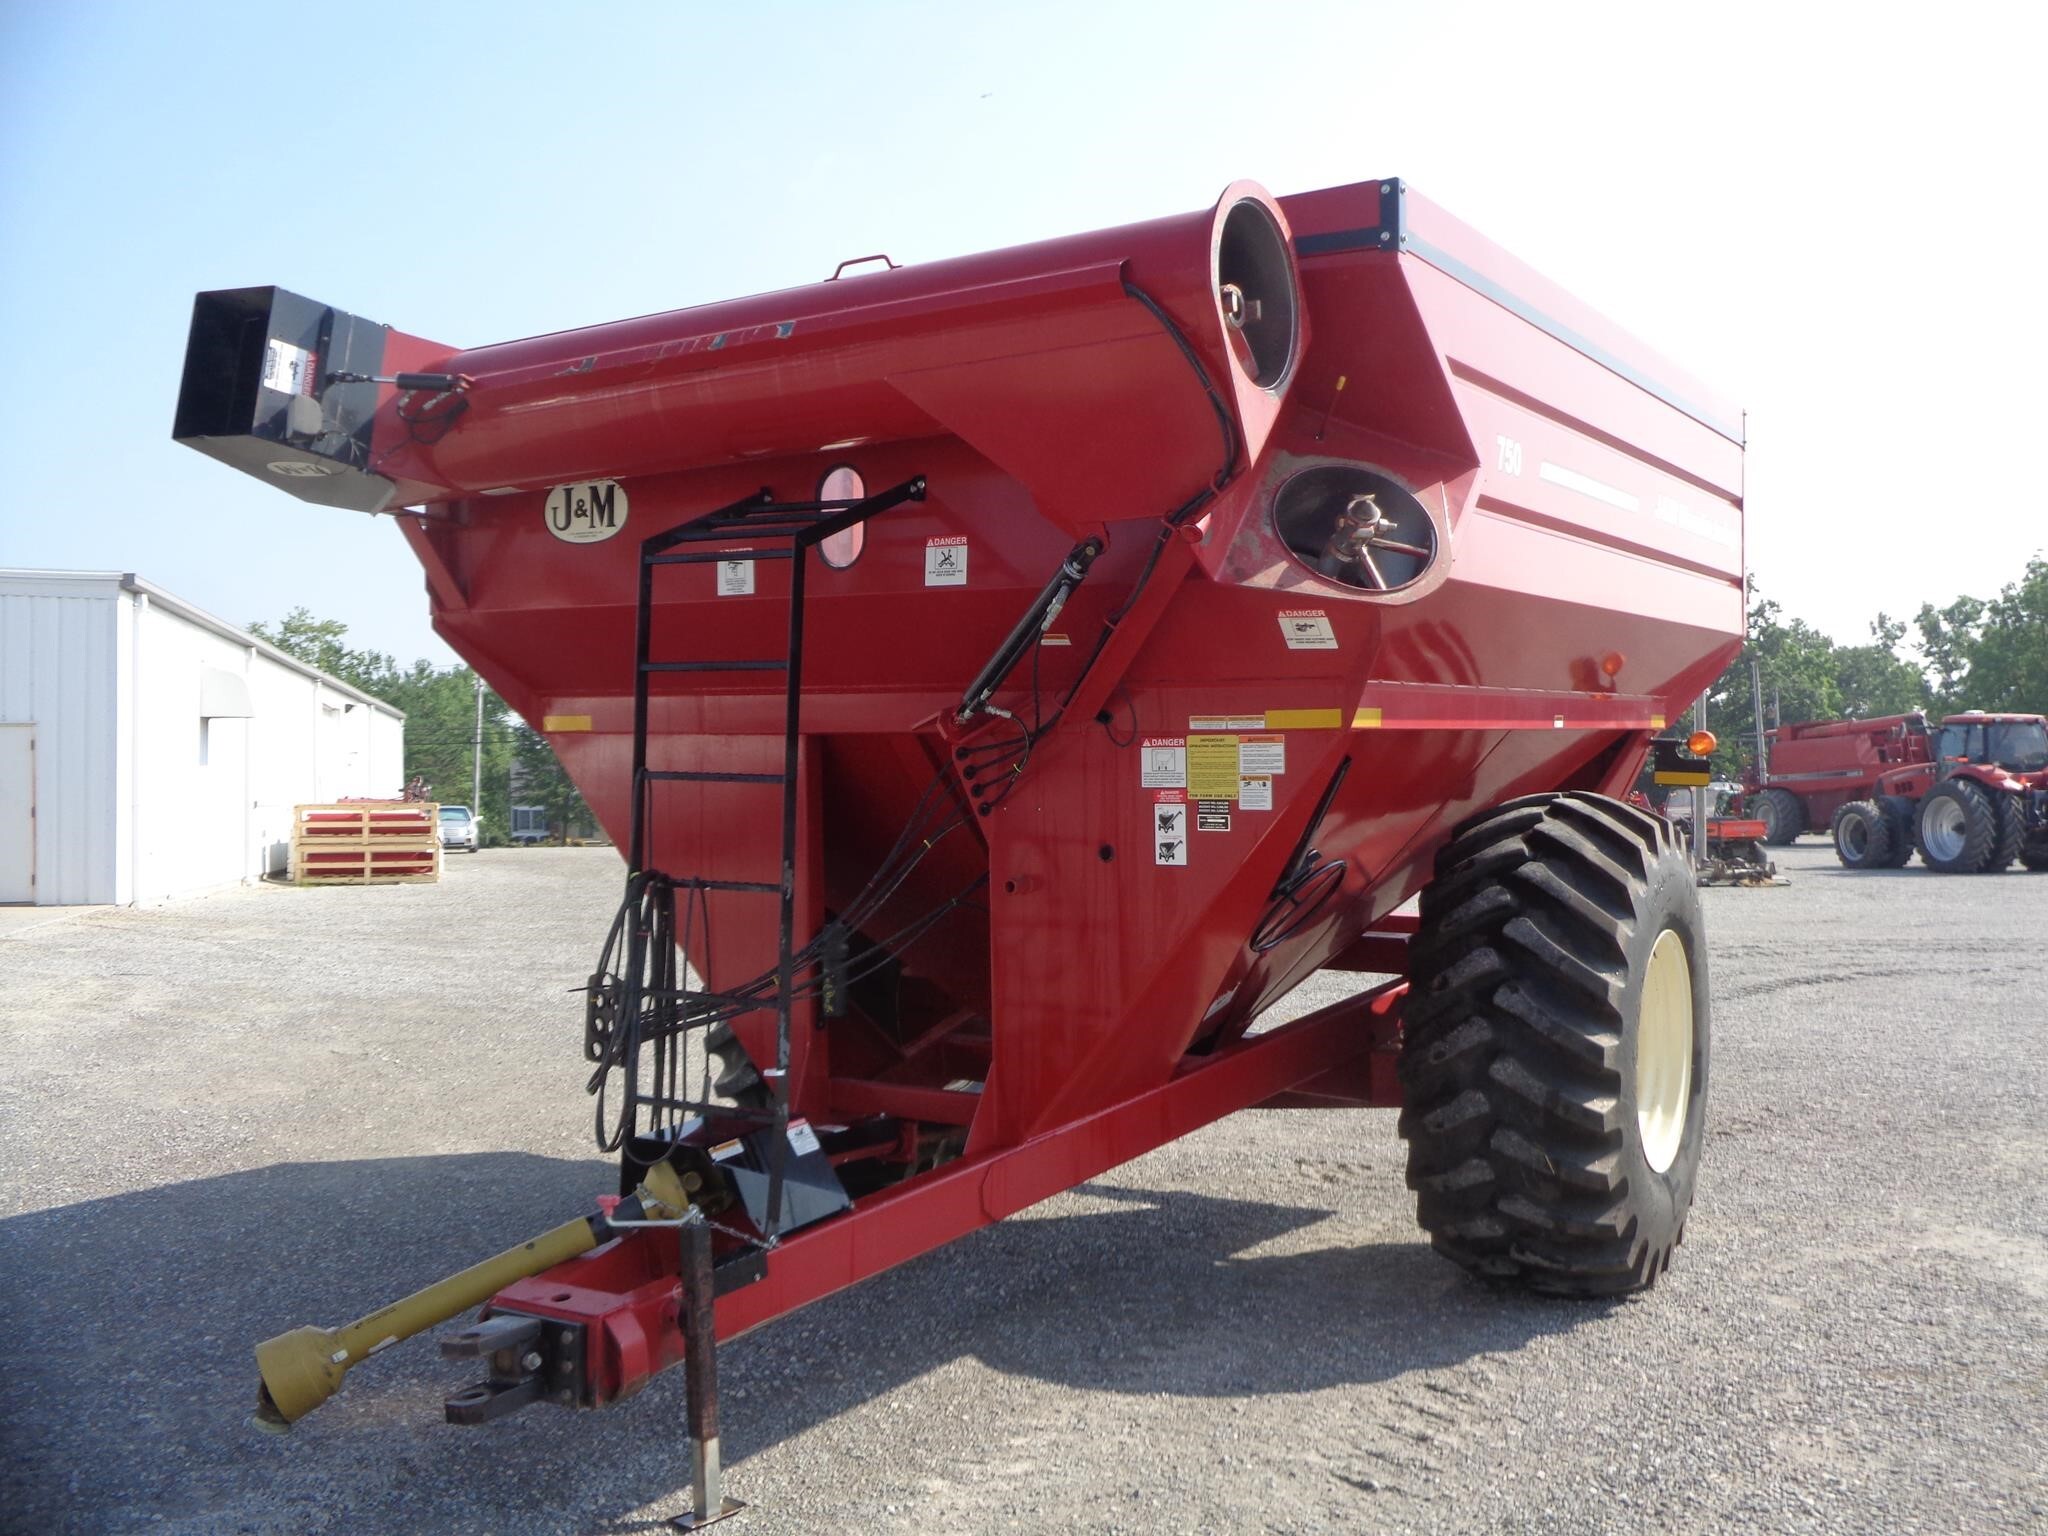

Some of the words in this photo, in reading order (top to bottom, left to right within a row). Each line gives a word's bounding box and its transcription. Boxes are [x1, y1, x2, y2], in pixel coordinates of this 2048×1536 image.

[1496, 434, 1523, 477] 750
[552, 484, 615, 531] J&M
[934, 537, 967, 546] DANGER
[1285, 609, 1325, 617] DANGER
[1151, 739, 1185, 747] DANGER
